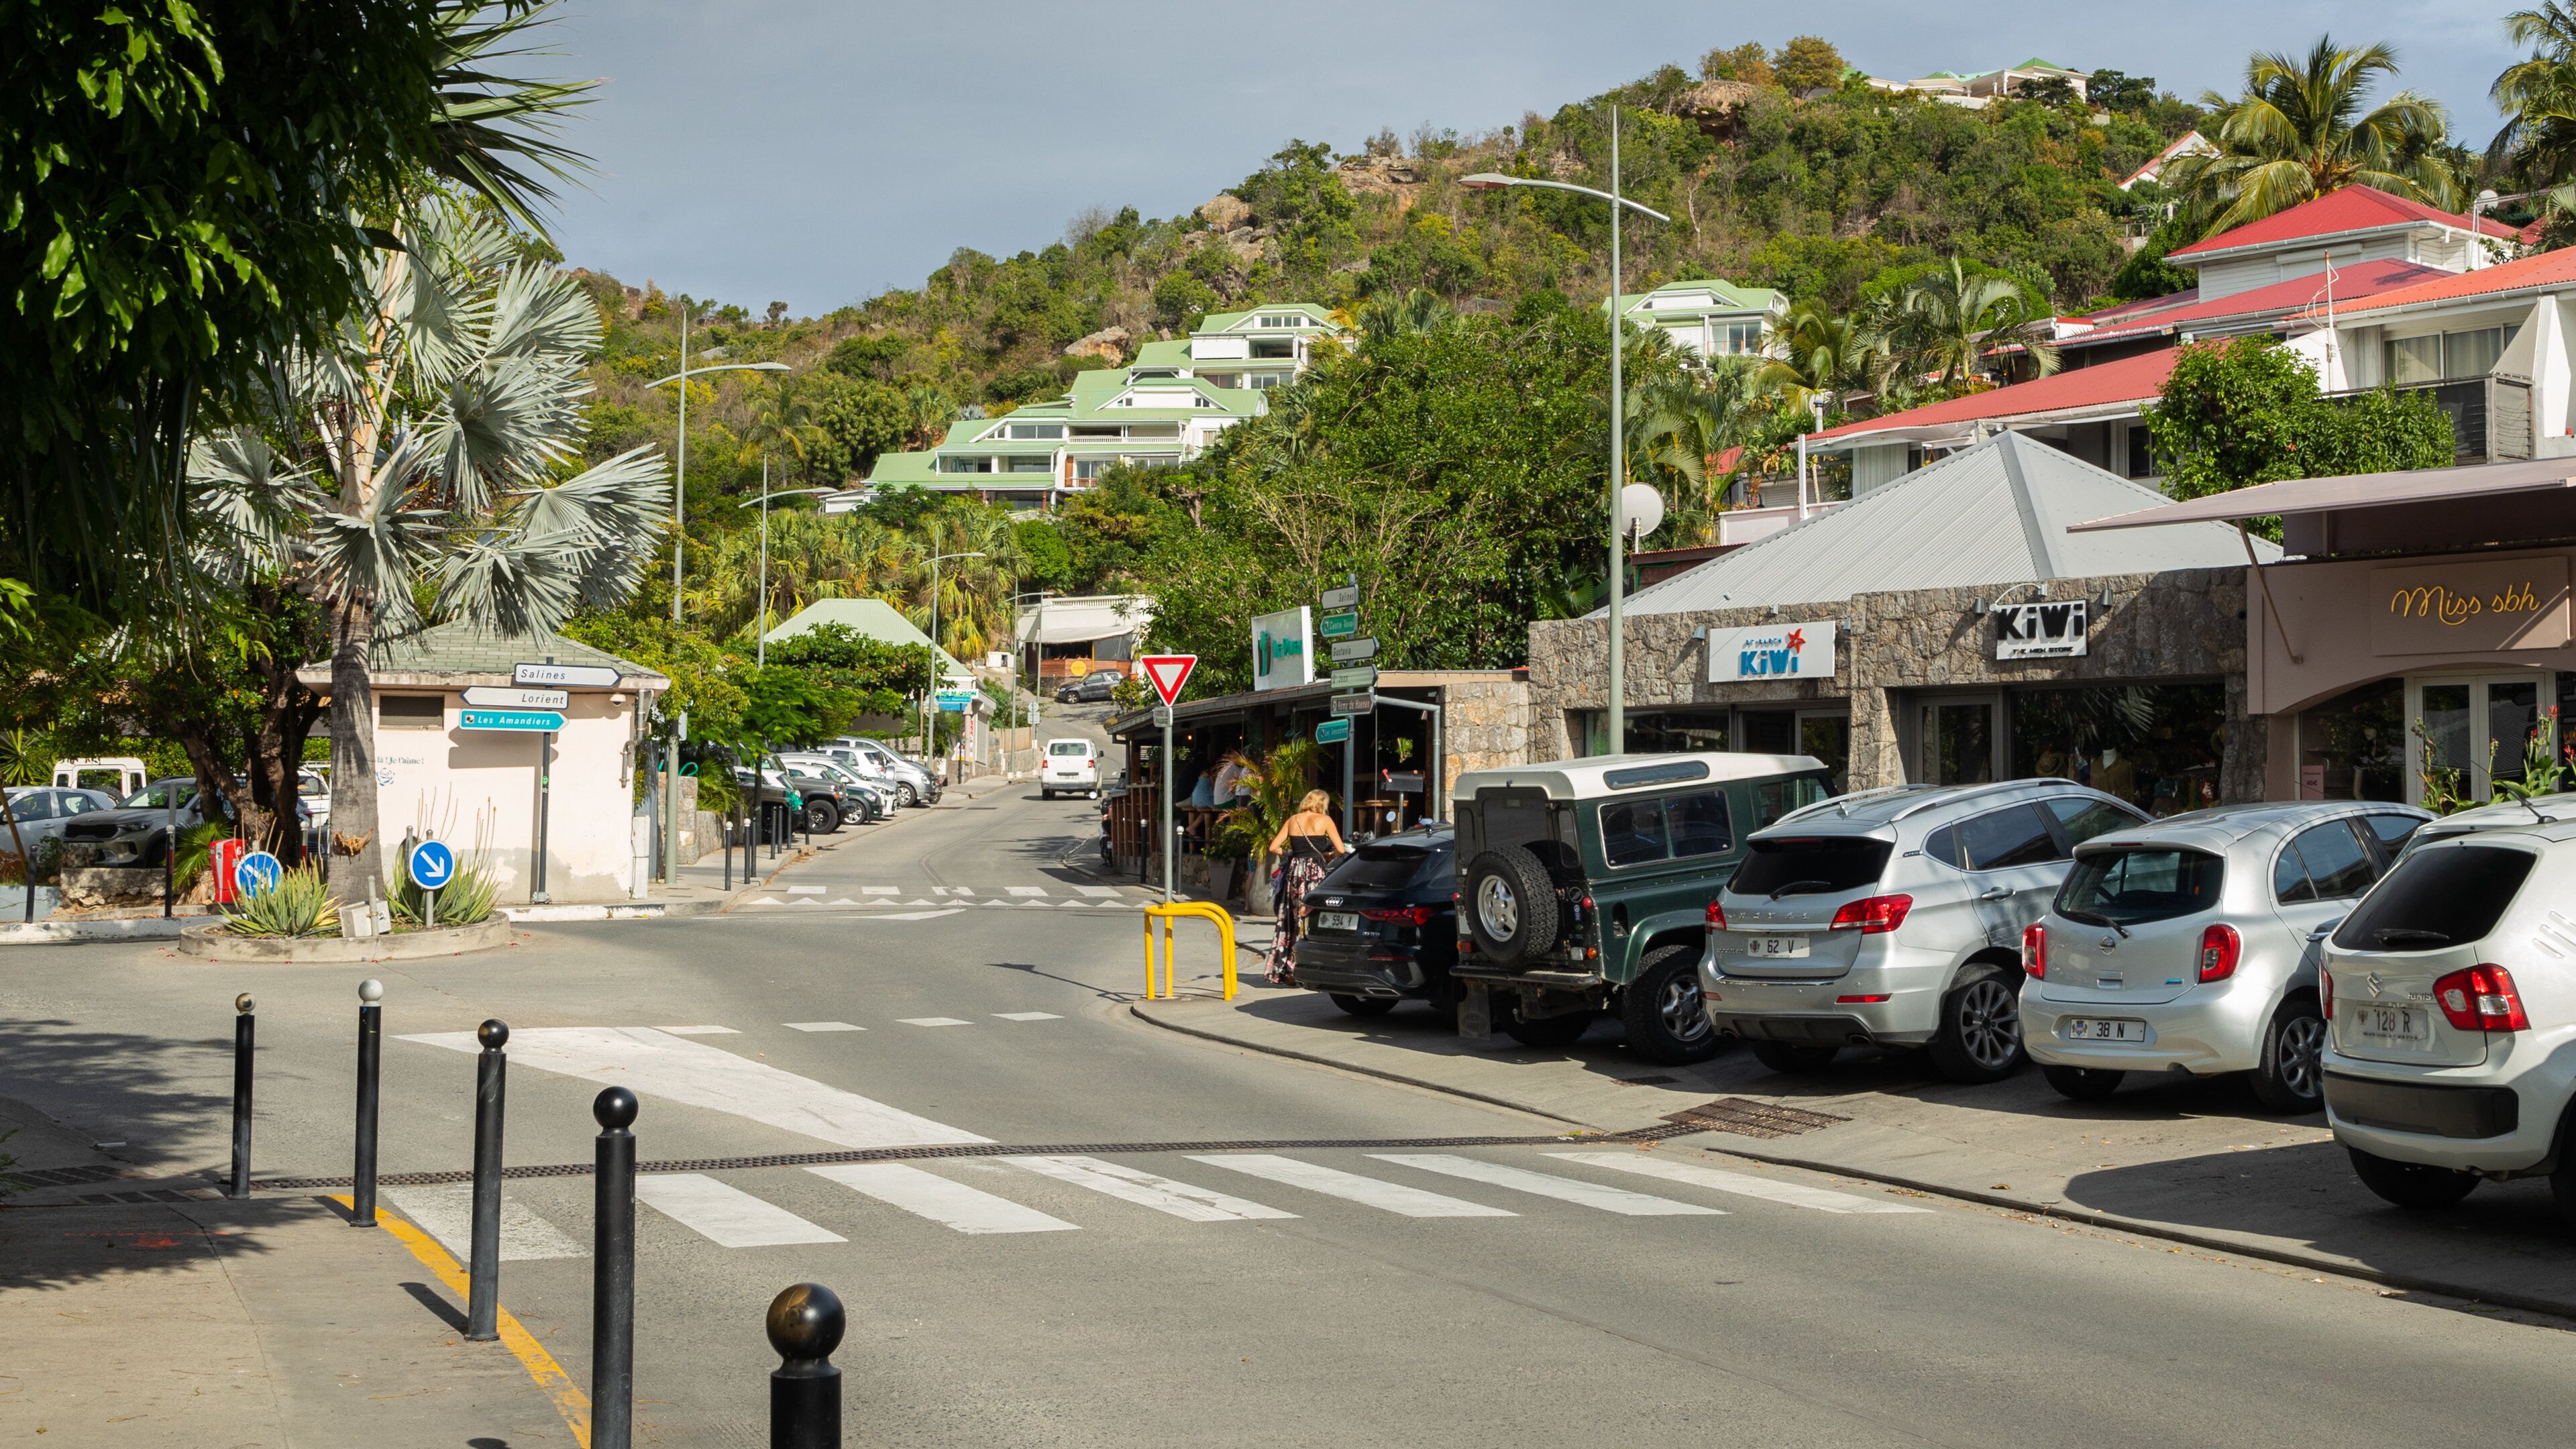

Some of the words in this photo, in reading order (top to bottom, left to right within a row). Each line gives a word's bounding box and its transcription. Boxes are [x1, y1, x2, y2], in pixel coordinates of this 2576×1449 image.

[1339, 593, 1354, 602] Salines
[2391, 586, 2481, 625] Miss
[2491, 582, 2541, 612] sbh
[1333, 645, 1351, 657] Gustavia
[521, 669, 566, 680] Salines
[522, 693, 564, 704] Lorient
[1349, 700, 1354, 709] de
[478, 716, 494, 724] Les
[499, 716, 551, 725] Amandiers
[1767, 940, 1779, 953] 62
[1788, 940, 1794, 953] V
[2376, 1010, 2396, 1032] 128
[2403, 1010, 2411, 1032] R
[2096, 1022, 2110, 1037] 38
[2116, 1022, 2125, 1038] N
